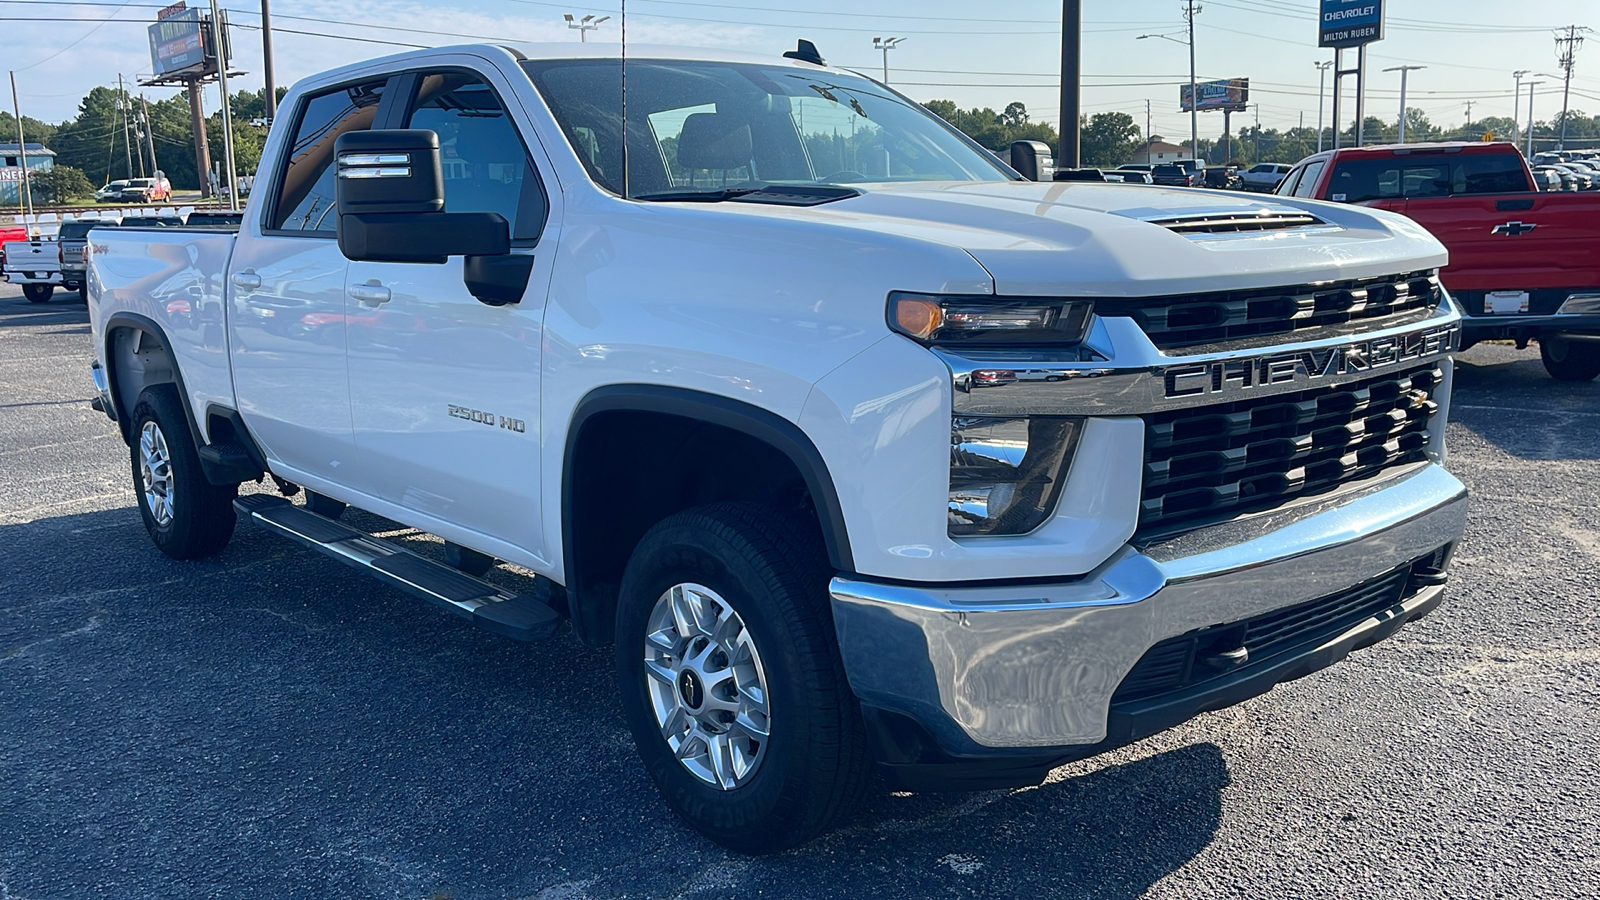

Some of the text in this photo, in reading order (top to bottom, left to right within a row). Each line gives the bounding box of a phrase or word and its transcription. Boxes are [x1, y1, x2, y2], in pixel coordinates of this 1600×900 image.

[1324, 6, 1375, 21] CHEVROLET
[1323, 27, 1375, 41] MILTON RUBEN
[1163, 323, 1459, 400] CHEVROLET
[447, 403, 525, 433] 2500 HD
